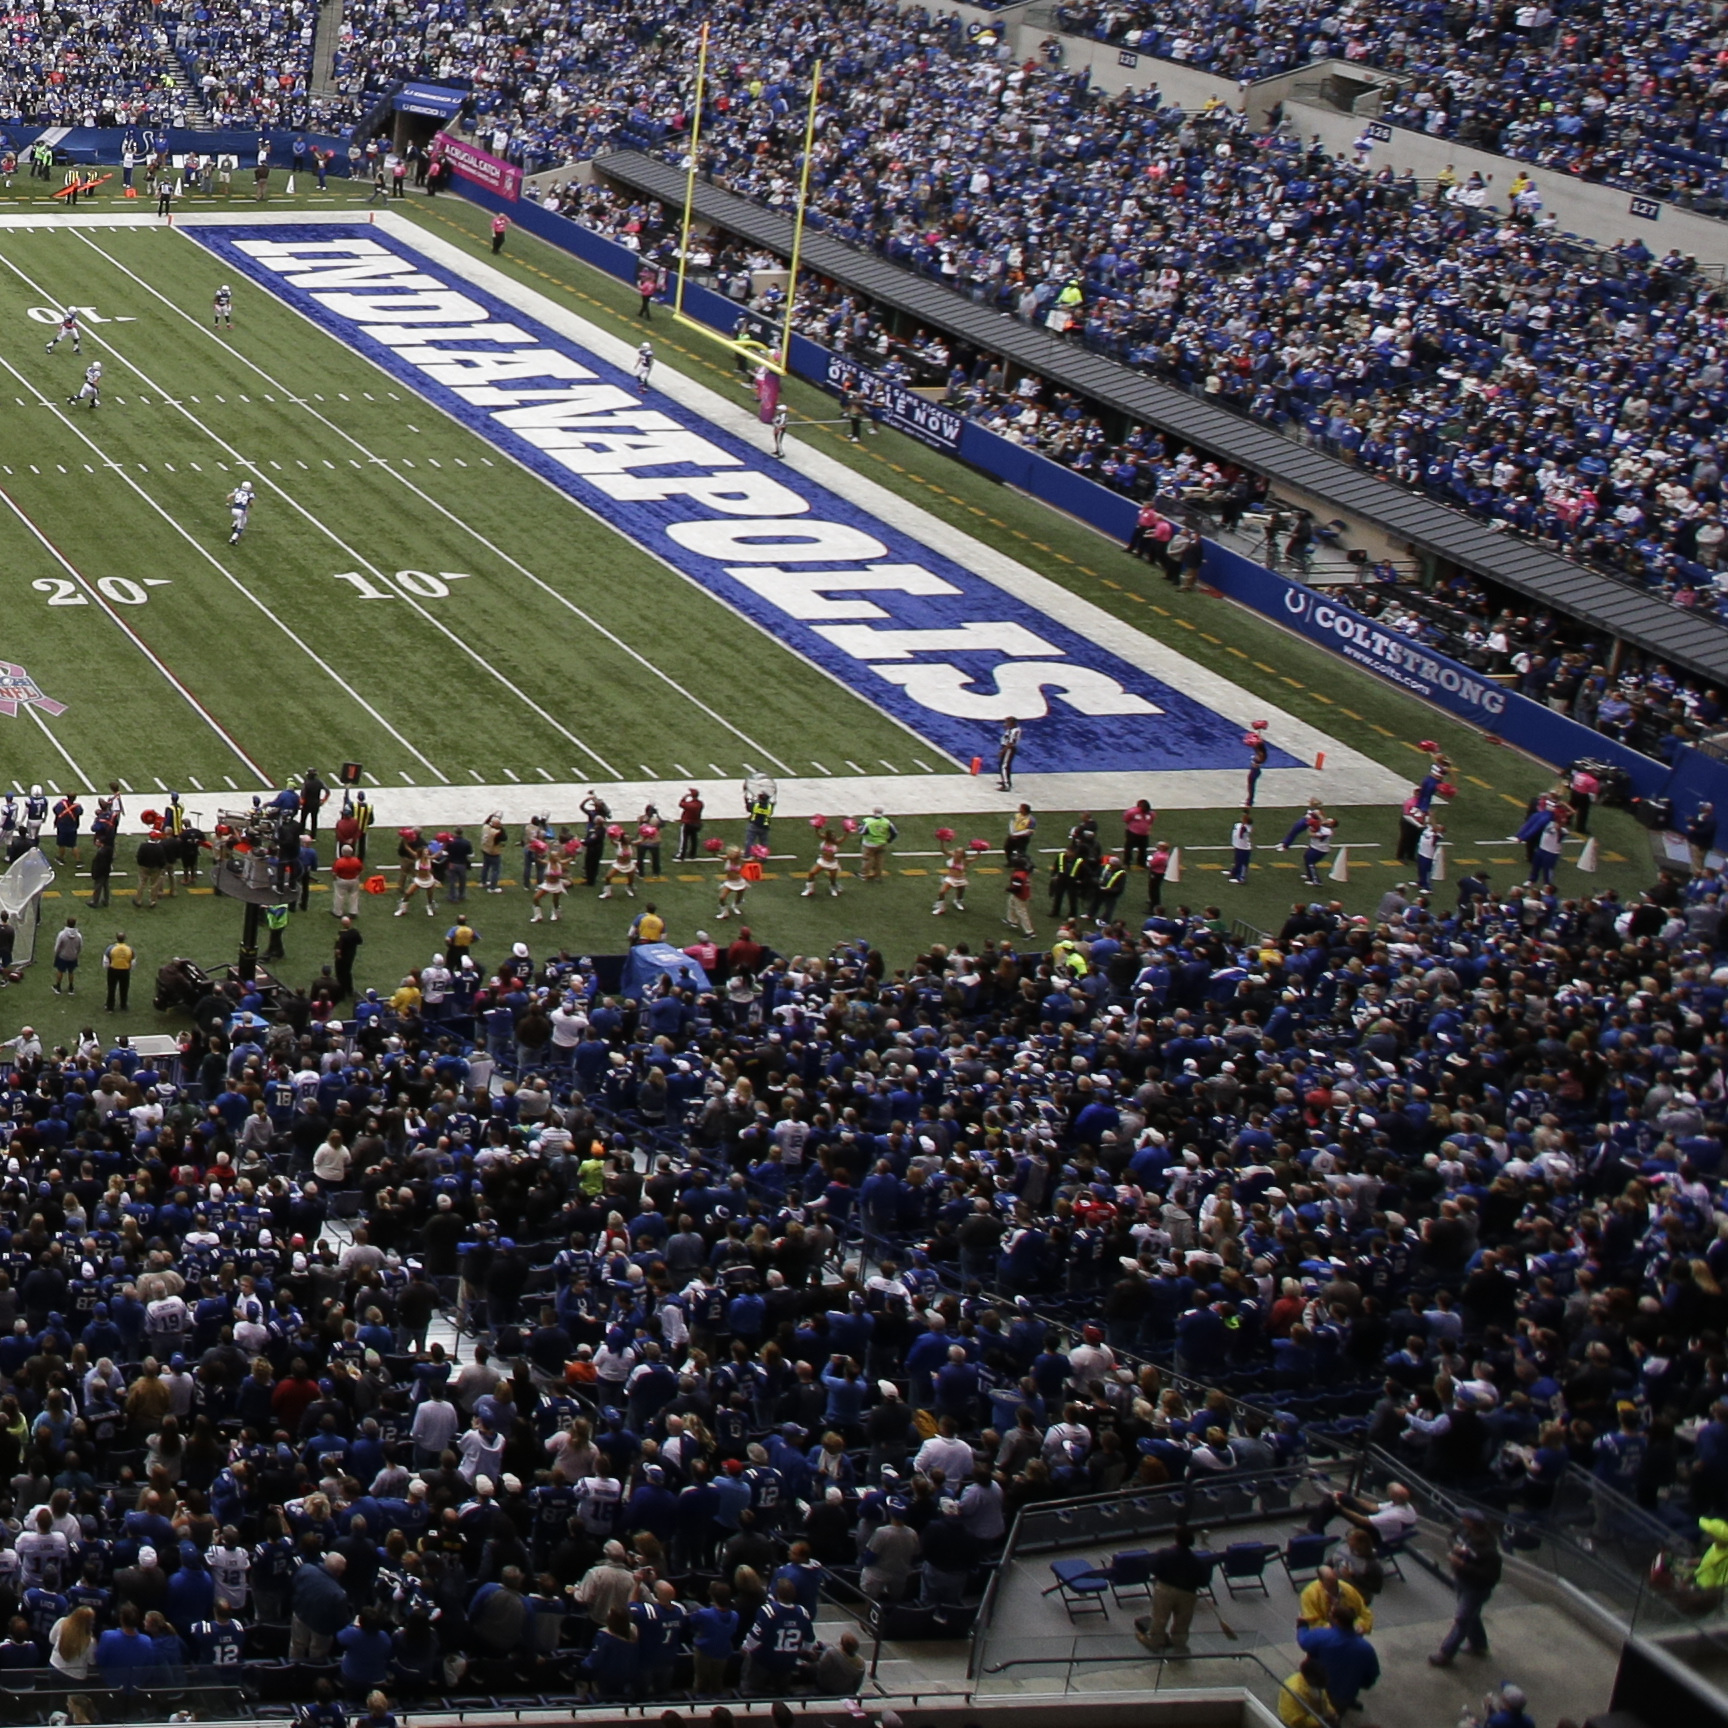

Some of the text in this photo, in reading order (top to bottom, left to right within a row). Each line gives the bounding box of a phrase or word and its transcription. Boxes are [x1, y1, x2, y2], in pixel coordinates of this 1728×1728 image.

[1632, 201, 1658, 216] 127
[914, 408, 960, 442] NOW
[920, 401, 962, 427] TICKETS
[233, 238, 1166, 722] INDIANAPOLIS
[32, 578, 149, 605] 20
[335, 571, 452, 600] 10
[1314, 605, 1506, 715] COLTSTRONG
[1343, 644, 1432, 696] www.colts.com
